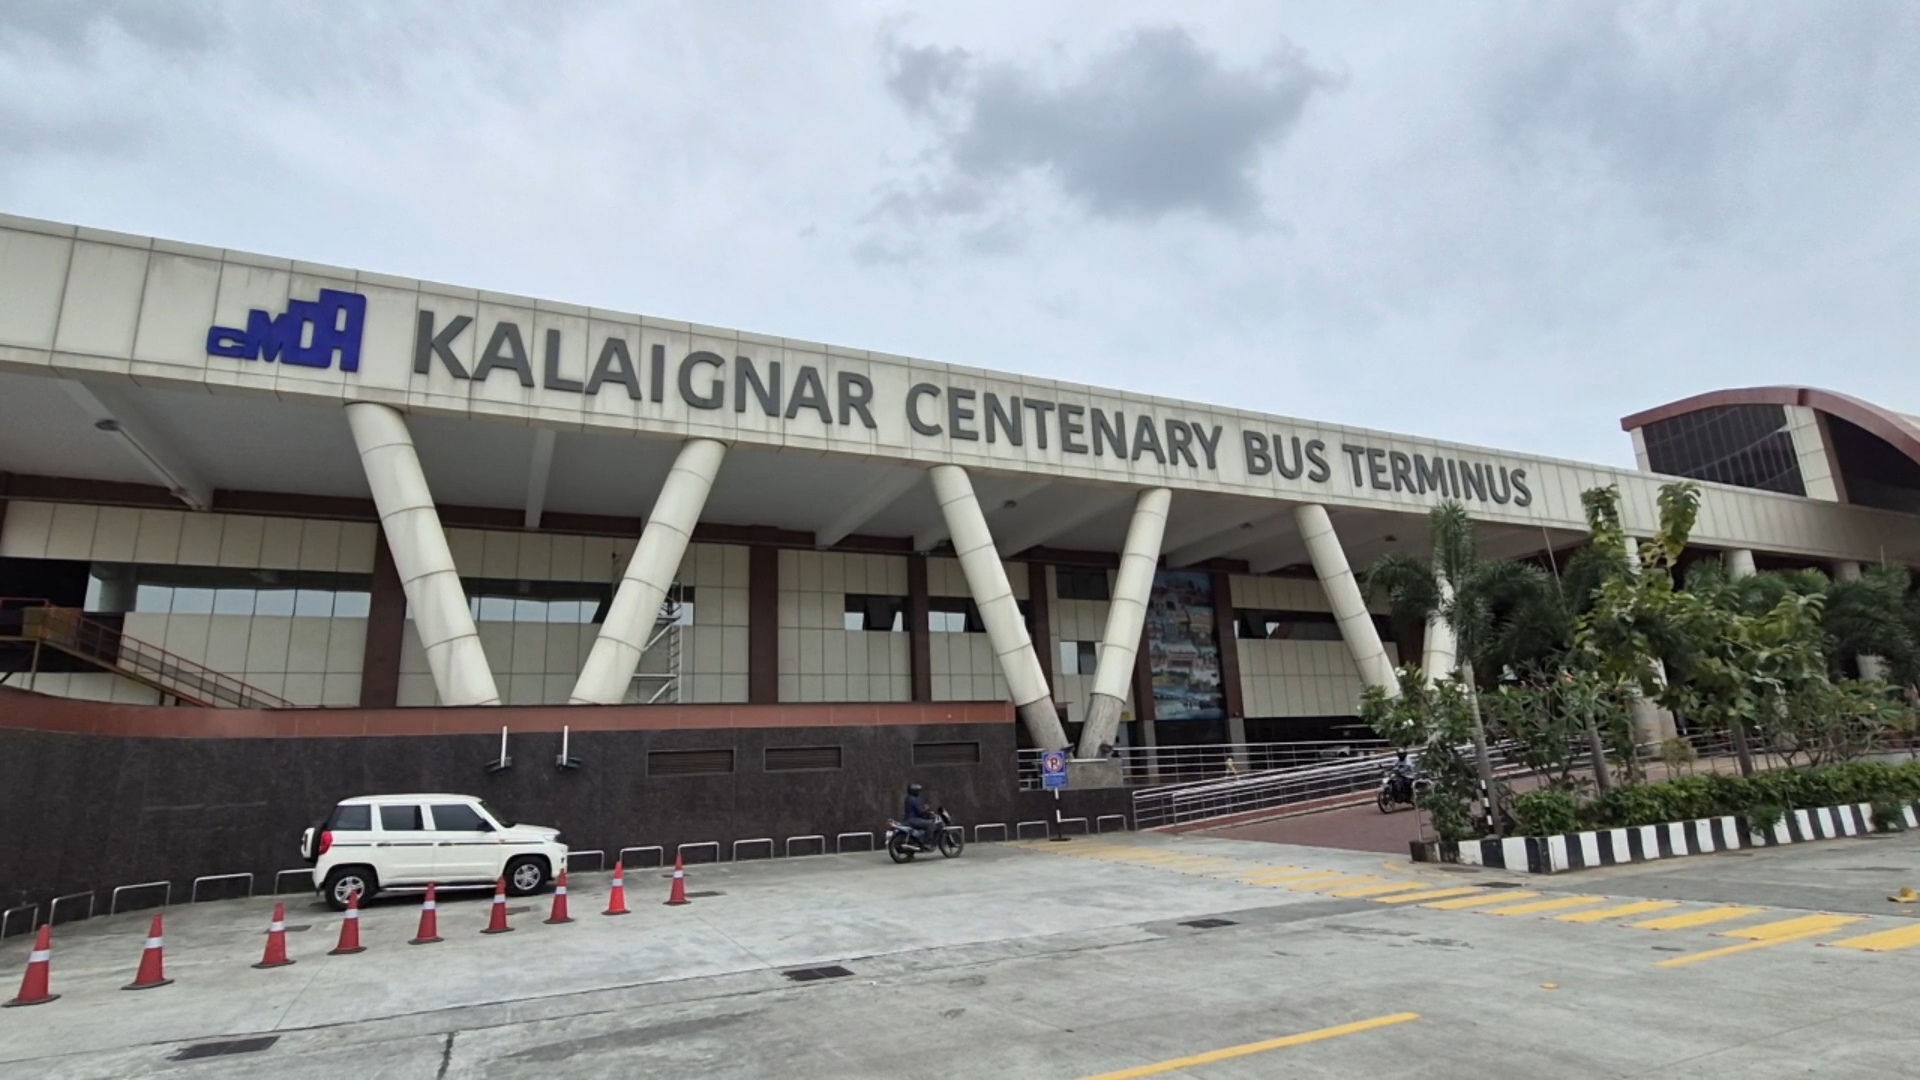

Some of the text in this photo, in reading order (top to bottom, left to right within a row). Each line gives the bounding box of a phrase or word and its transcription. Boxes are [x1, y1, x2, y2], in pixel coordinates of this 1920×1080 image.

[414, 310, 1533, 507] KALAIGNAR CENTENARY BUS TERMINUS
